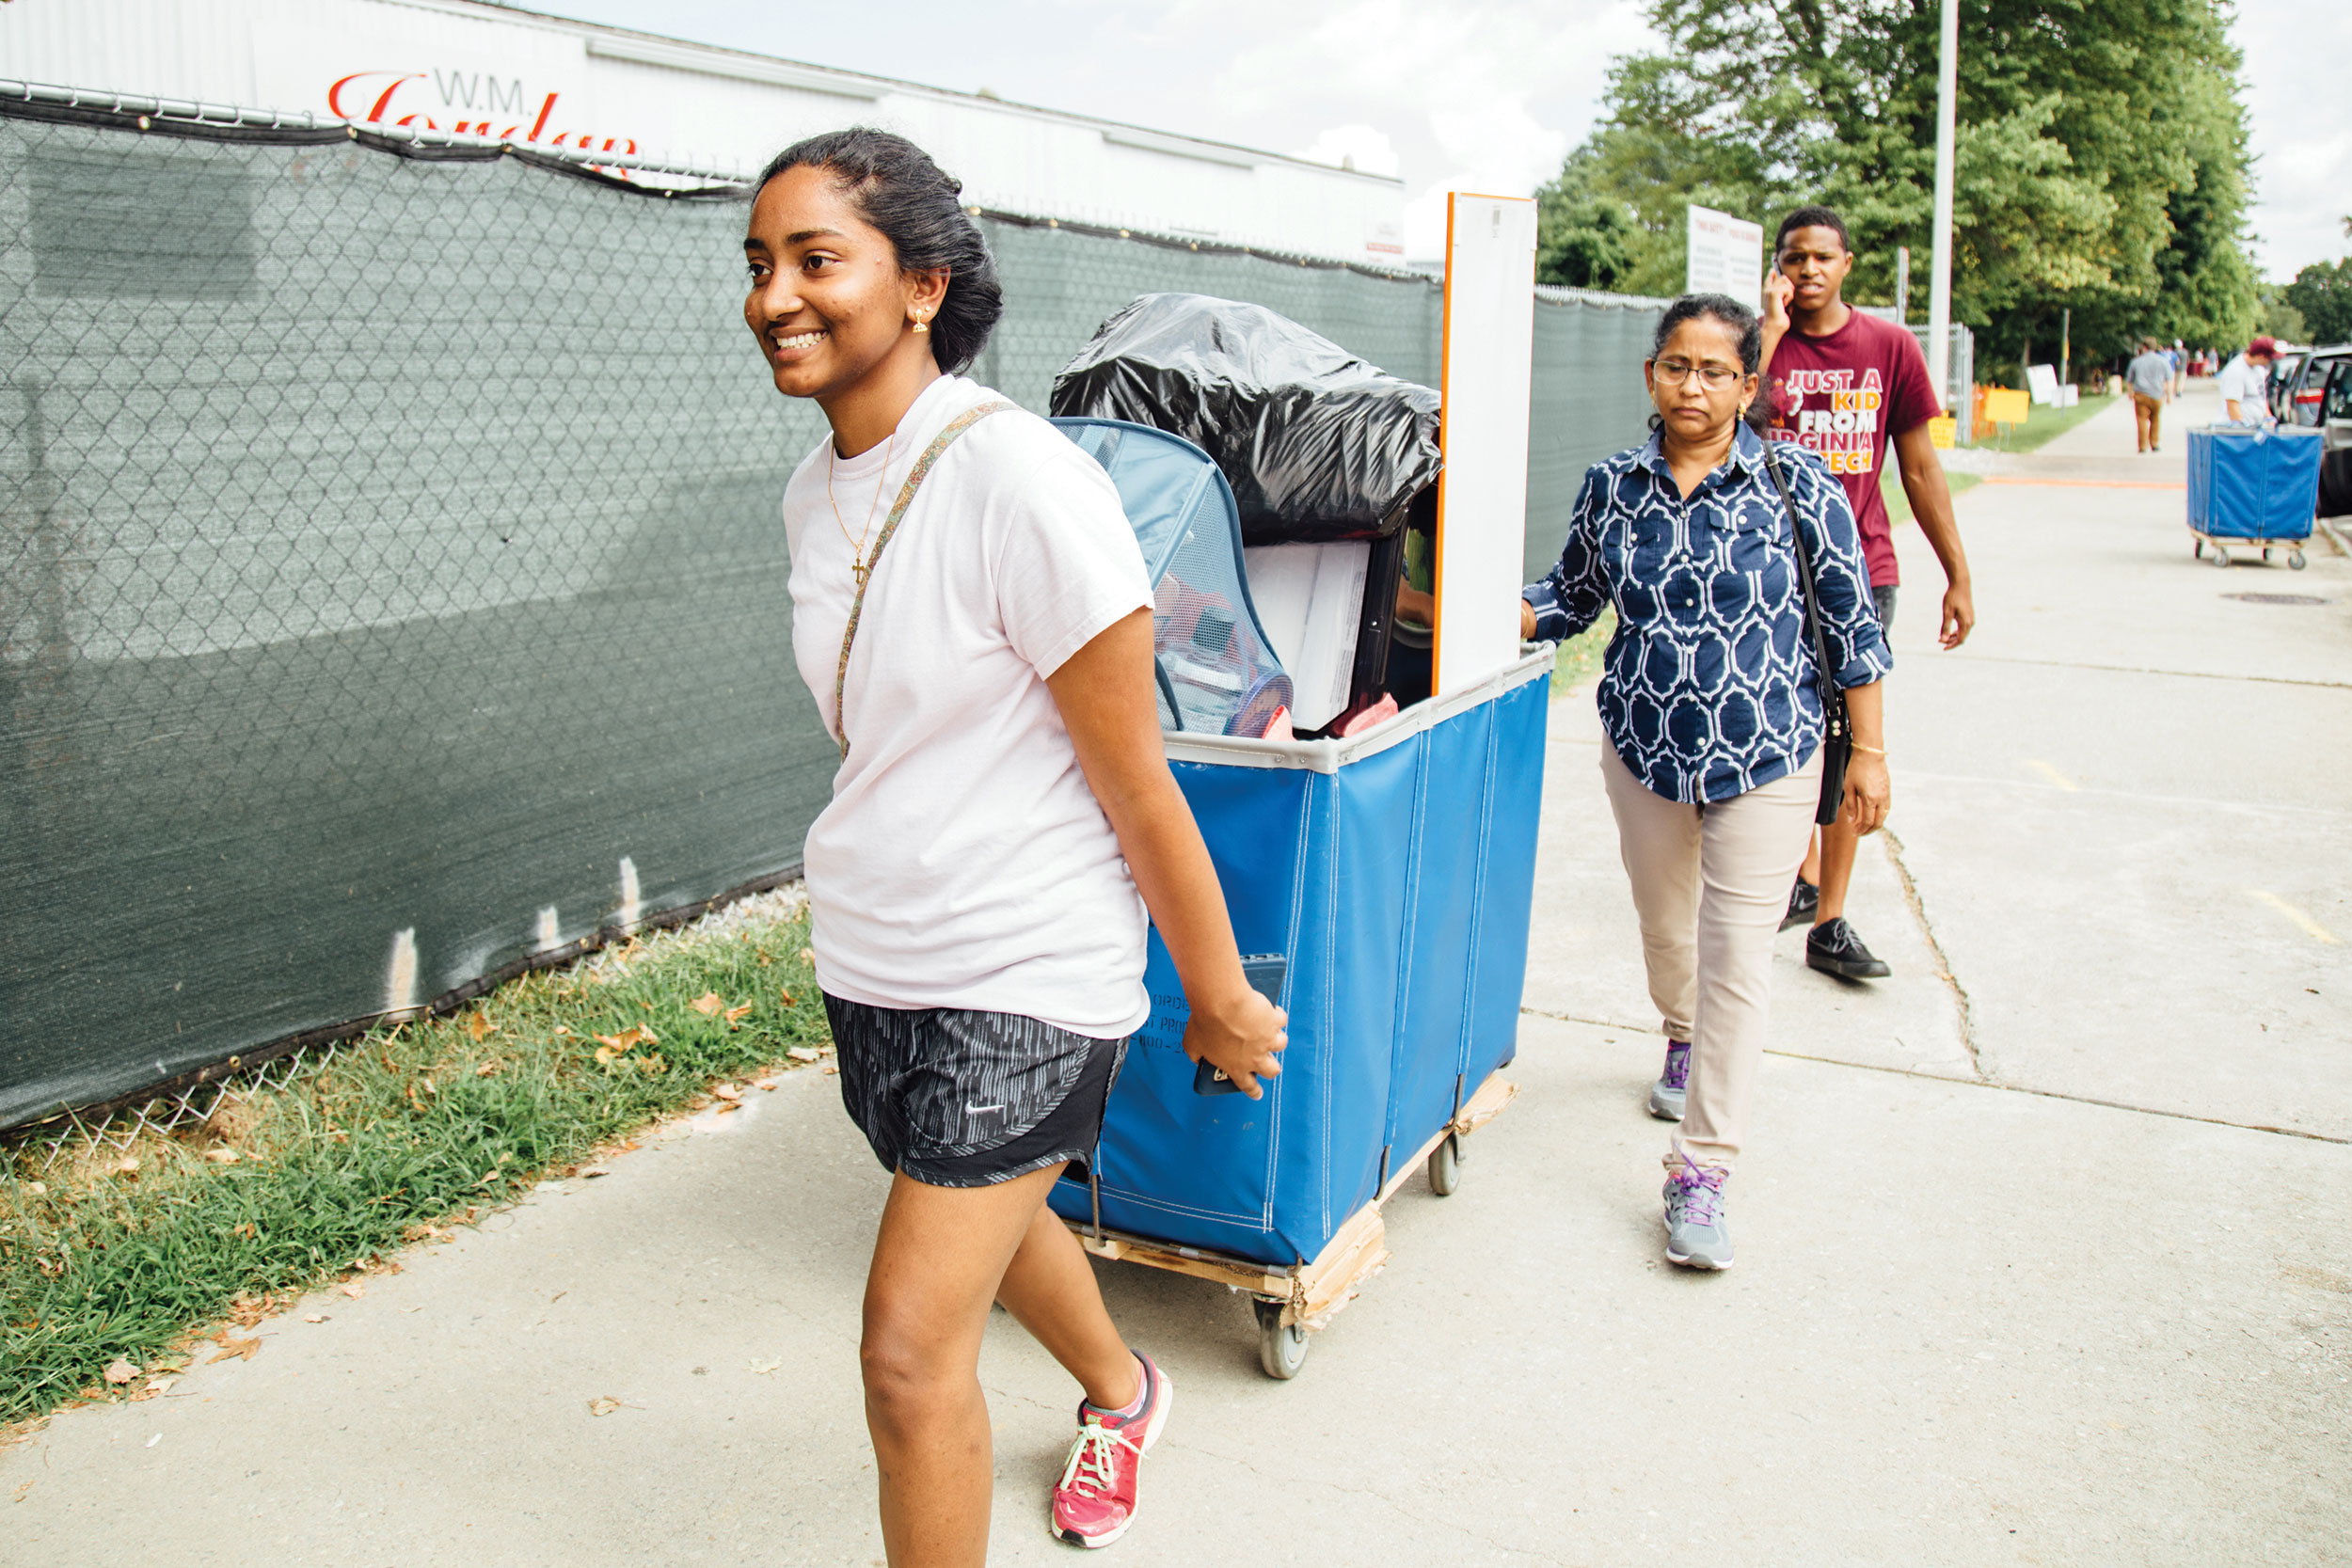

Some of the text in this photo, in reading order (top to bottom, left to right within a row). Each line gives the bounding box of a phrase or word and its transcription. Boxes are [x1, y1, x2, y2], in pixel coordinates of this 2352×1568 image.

[433, 68, 532, 117] W.M.
[1786, 368, 1883, 394] JUST A
[1832, 389, 1882, 413] KID
[1800, 409, 1877, 433] FROM
[1762, 428, 1874, 452] IRGINIA
[1152, 993, 1191, 1012] ORDE
